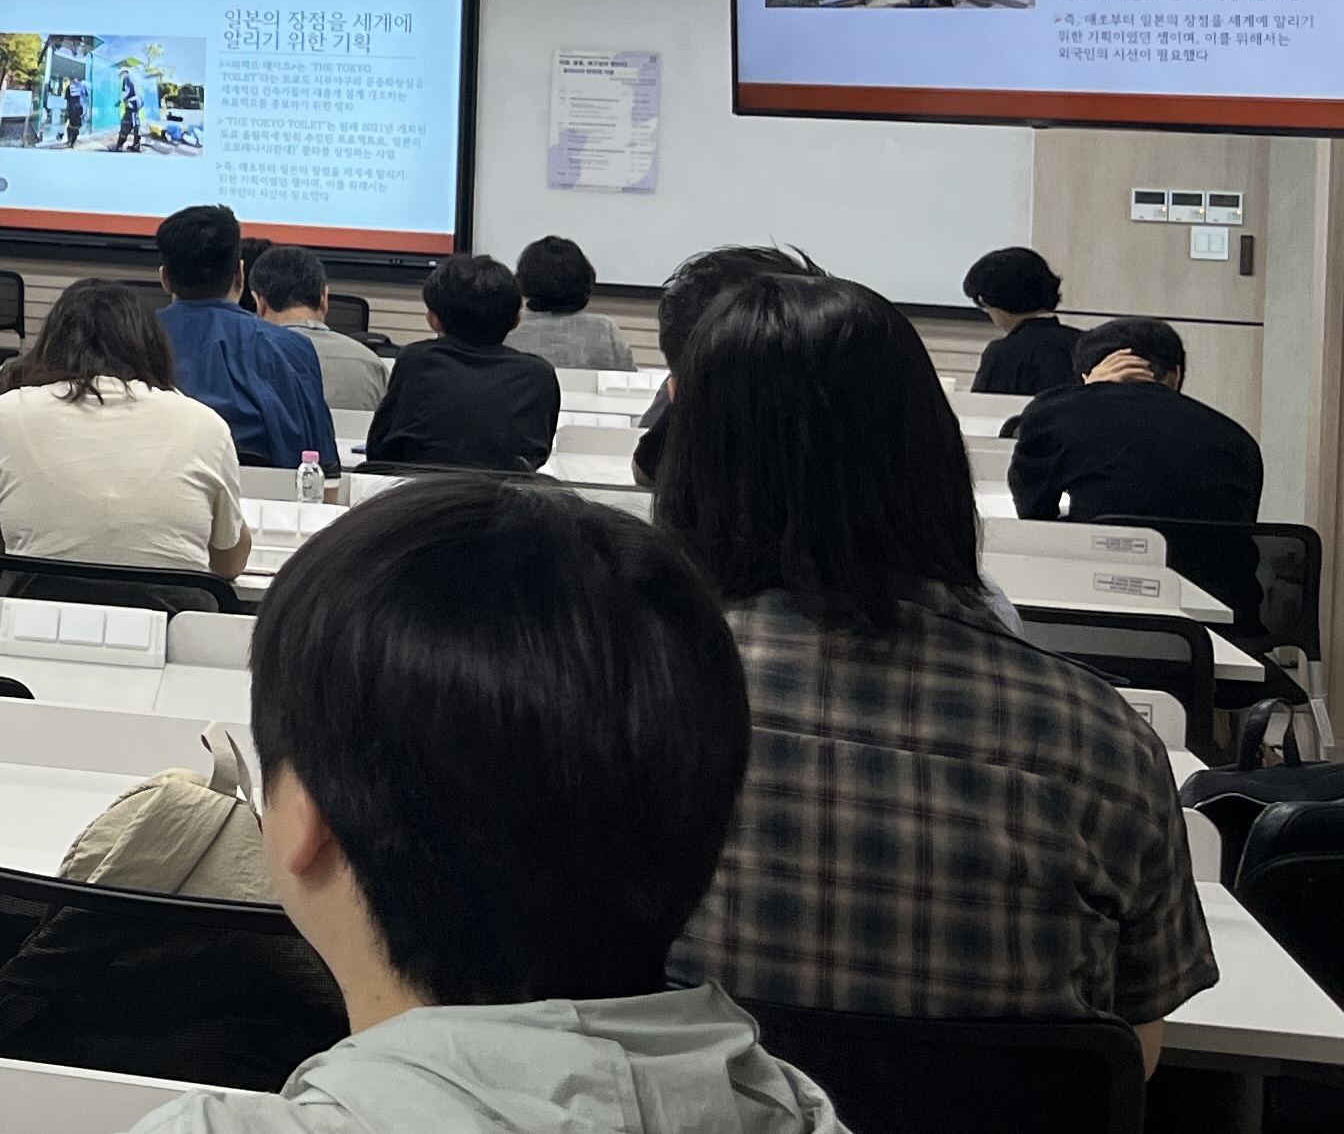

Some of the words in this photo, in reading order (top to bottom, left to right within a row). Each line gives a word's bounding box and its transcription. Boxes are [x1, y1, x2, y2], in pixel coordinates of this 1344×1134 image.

[224, 9, 280, 31] 일본의
[287, 10, 347, 32] 장점을
[353, 12, 412, 34] 세계에
[1140, 13, 1179, 28] 일본의
[1182, 13, 1224, 28] 장점을
[1228, 13, 1269, 29] 세계에
[1273, 13, 1315, 29] 알리기
[223, 30, 279, 51] 알리기
[287, 31, 326, 53] 위한
[332, 32, 371, 54] 기획
[1236, 30, 1292, 47] 위해서는
[1058, 46, 1109, 62] 외국인의
[1113, 47, 1151, 63] 시선이
